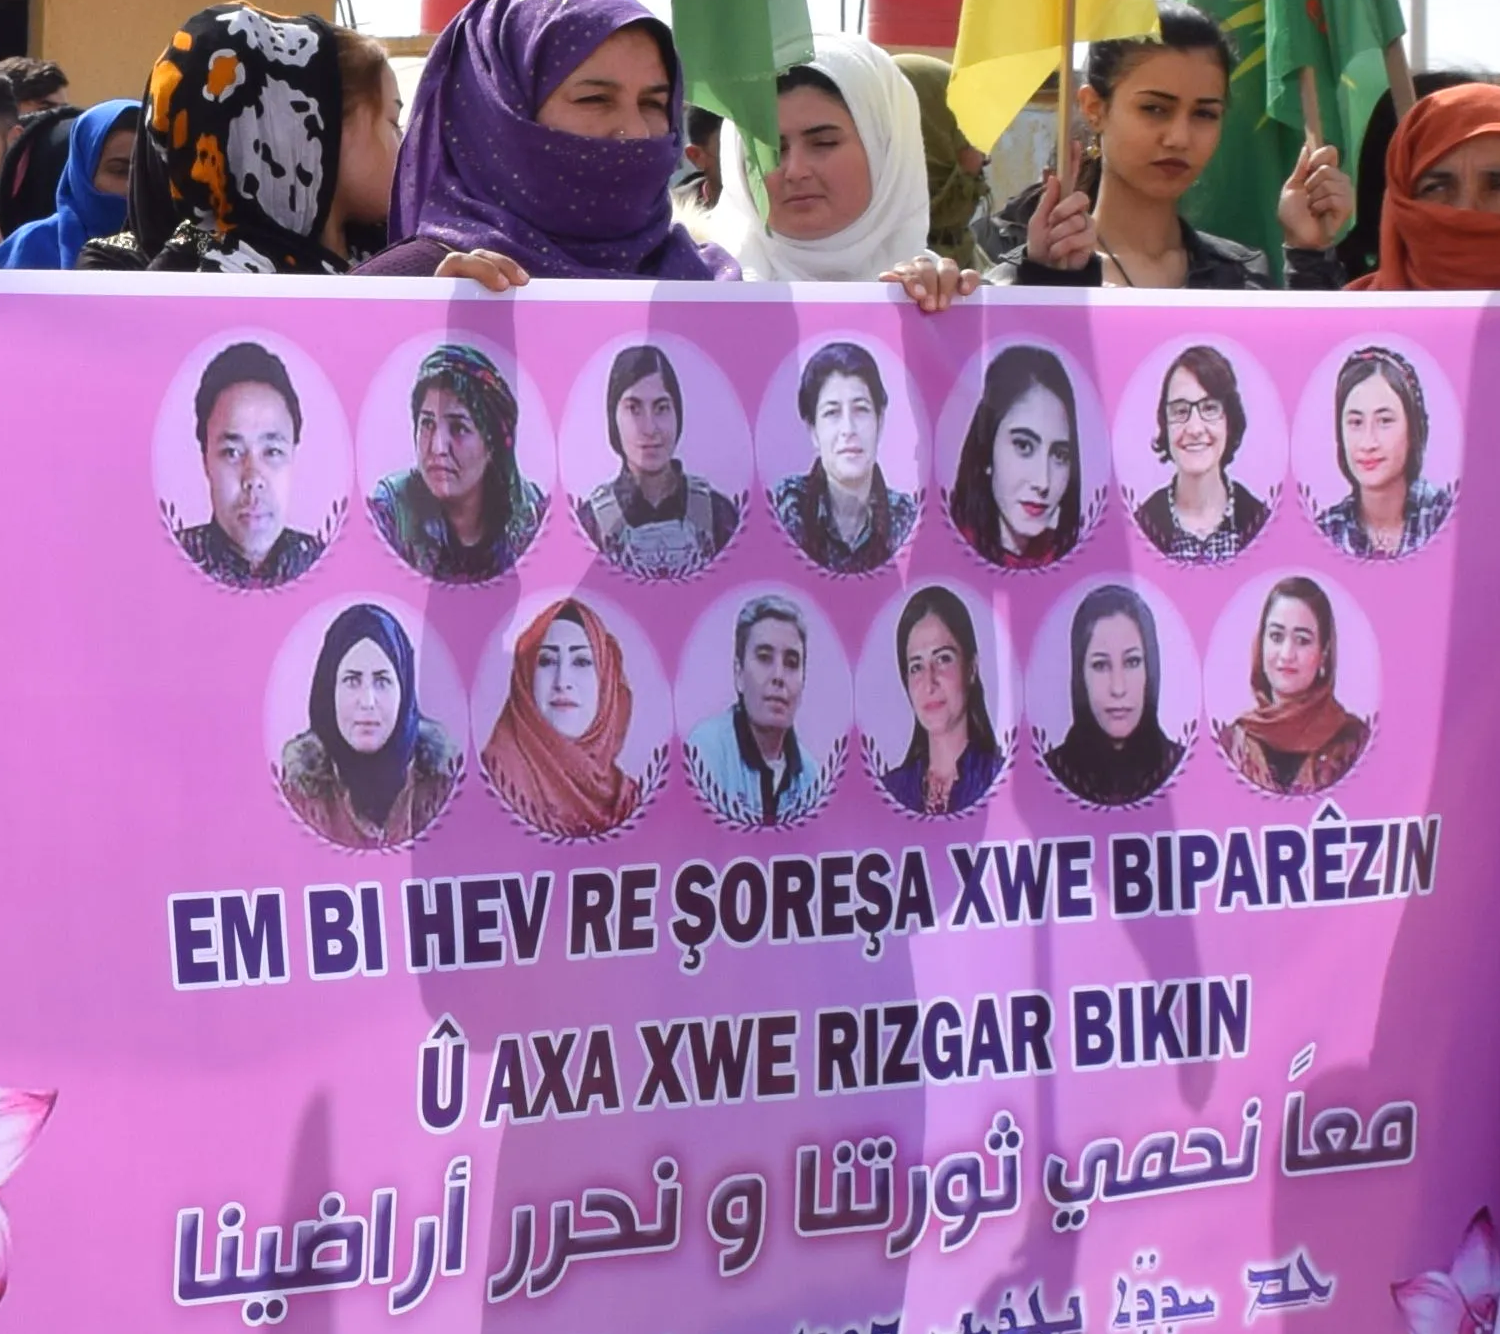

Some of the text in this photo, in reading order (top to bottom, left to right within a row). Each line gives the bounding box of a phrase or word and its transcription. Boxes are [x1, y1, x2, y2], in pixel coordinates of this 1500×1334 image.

[170, 802, 1440, 987] EM BI HEV RE ŞOREŞA XWE BIPARÊZIN
[420, 977, 1251, 1131] Û AXA XWE RIZGAR BIKIN
[176, 1049, 1416, 1325] معاً نحمي ثورتنا و نحرر أراضينا
